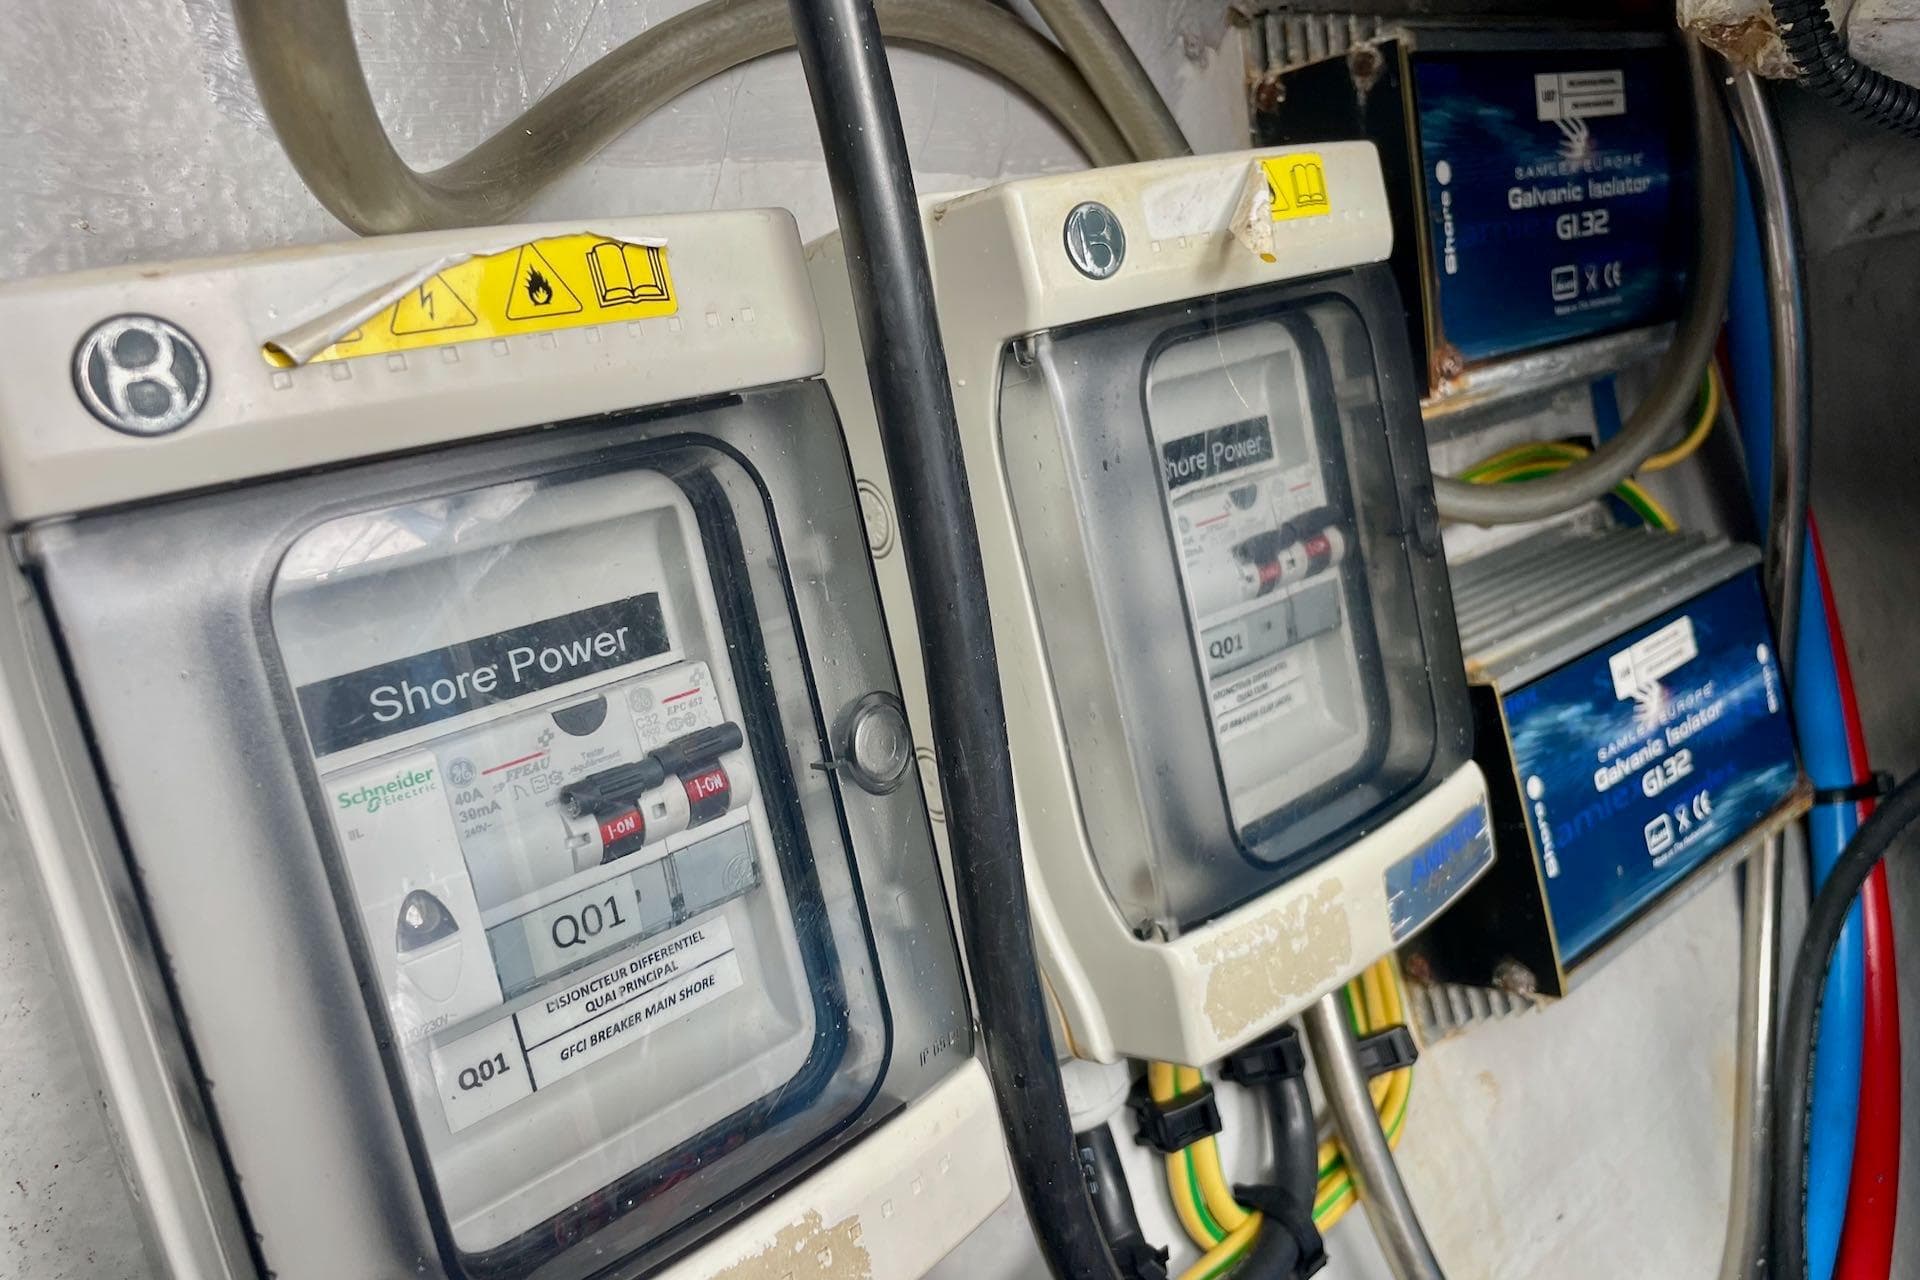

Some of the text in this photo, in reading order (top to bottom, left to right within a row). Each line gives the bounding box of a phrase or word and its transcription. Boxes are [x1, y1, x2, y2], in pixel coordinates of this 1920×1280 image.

[1583, 151, 1645, 173] EUROPE
[1508, 174, 1652, 210] Galvanic Isolator
[1211, 436, 1263, 467] Power
[1209, 632, 1243, 660] Q01
[368, 623, 630, 723] Shore Power
[1594, 738, 1667, 793] Galvanic
[1665, 699, 1724, 747] Isolator
[337, 767, 435, 810] Schneider
[383, 782, 438, 807] Electric
[454, 788, 484, 807] 40A
[607, 816, 636, 840] I-ON
[552, 895, 626, 949] Q01
[546, 930, 706, 1014] DISJONCTEUR DIFFERENTIEL
[585, 960, 680, 1014] QUAI PRINCIPAL
[560, 974, 717, 1061] GFCI BREAKER MAIN SHORE
[457, 1051, 511, 1093] Q01
